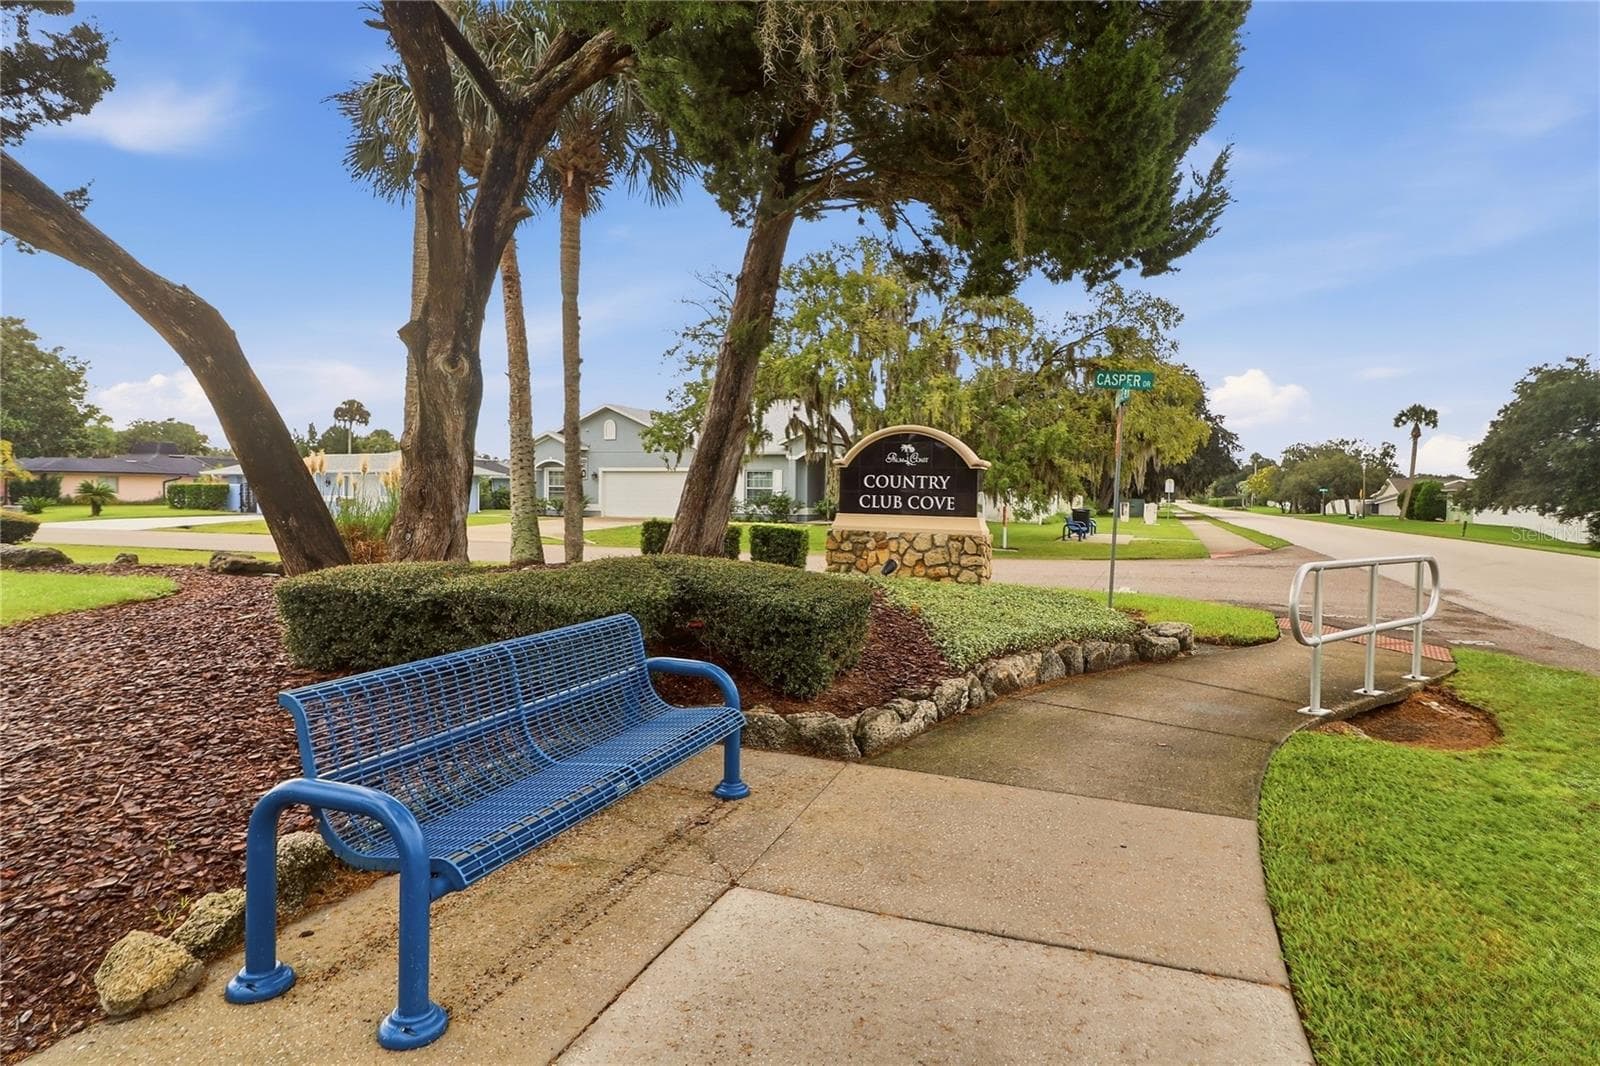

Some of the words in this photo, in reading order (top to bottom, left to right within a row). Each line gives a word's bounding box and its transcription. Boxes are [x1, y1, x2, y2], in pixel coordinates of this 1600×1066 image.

[1096, 373, 1142, 387] CASPER
[863, 474, 951, 490] COUNTRY
[858, 494, 903, 509] CLUB
[907, 495, 956, 511] COVE
